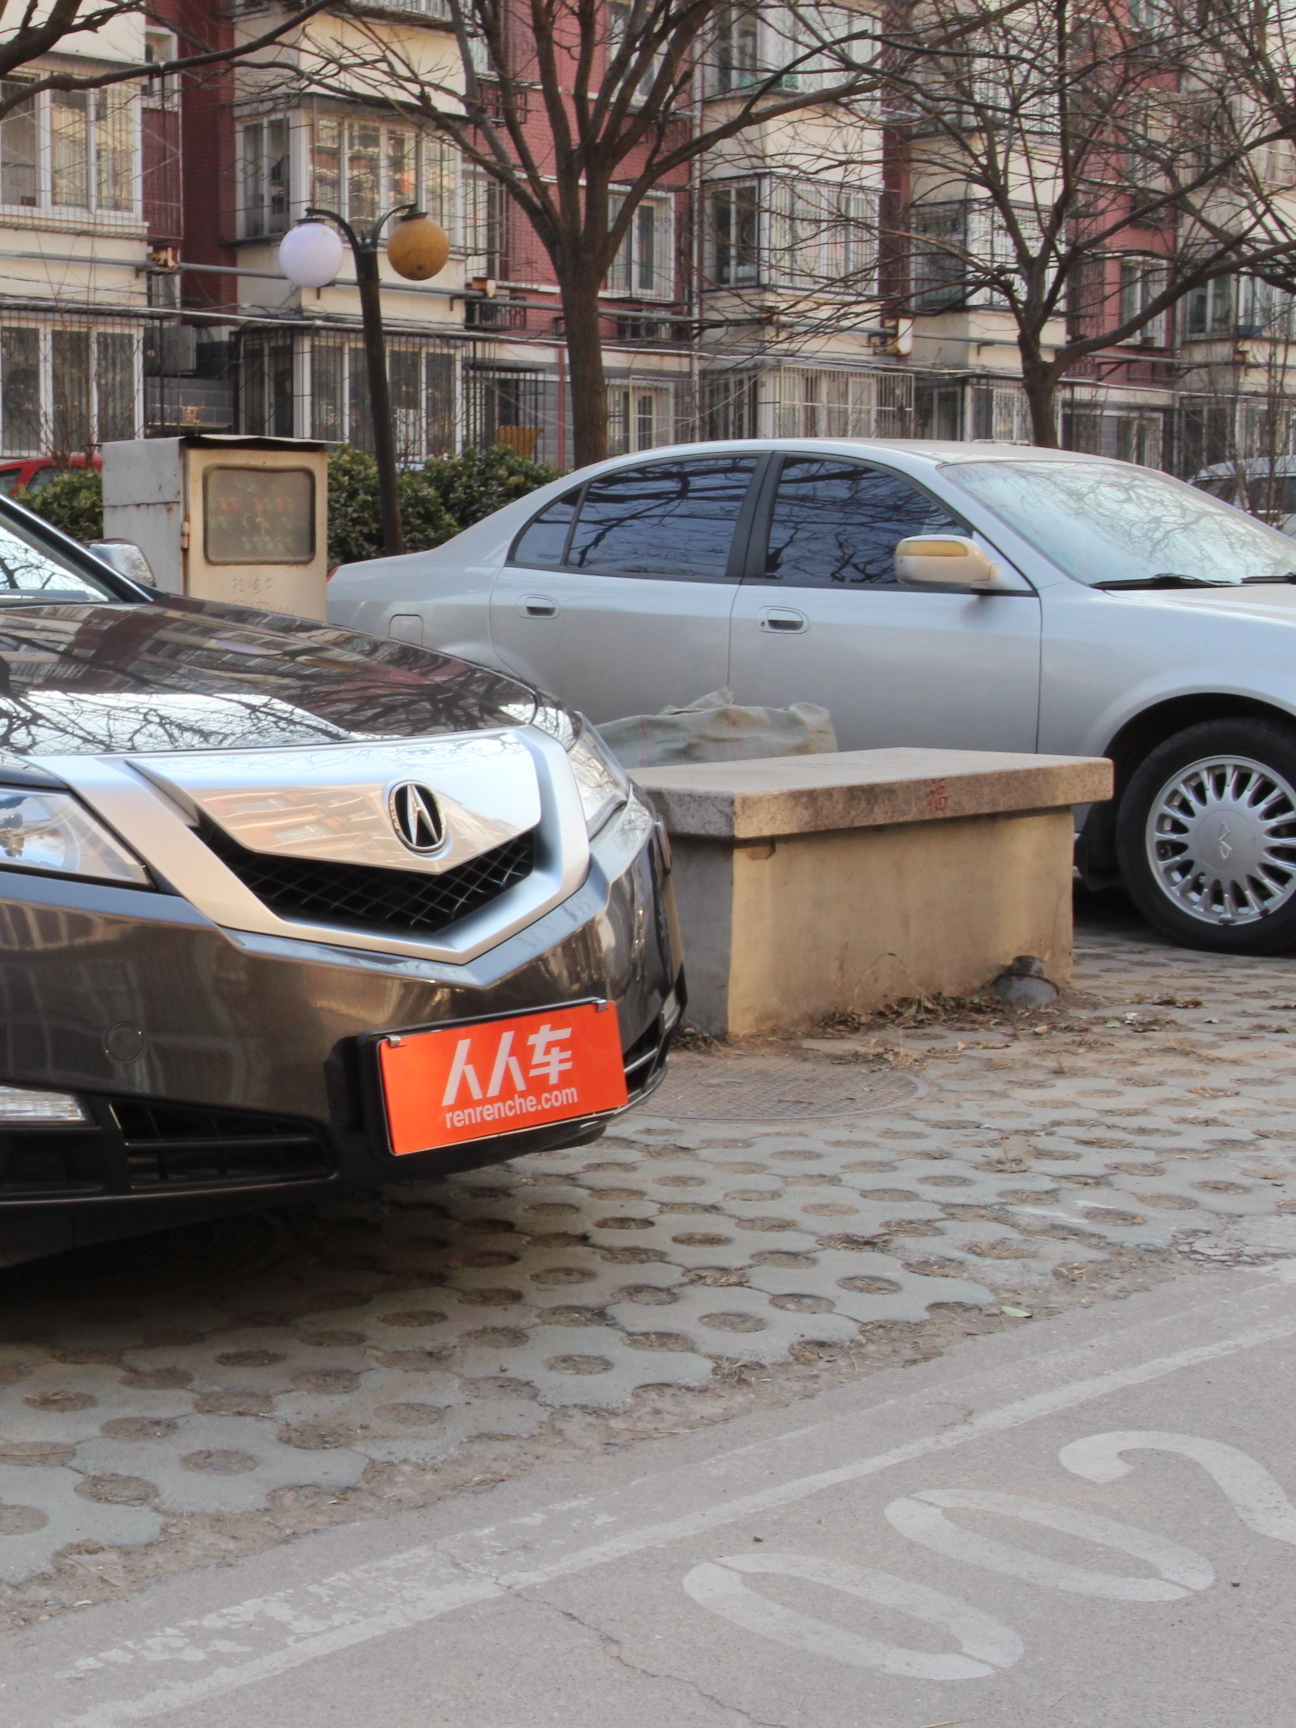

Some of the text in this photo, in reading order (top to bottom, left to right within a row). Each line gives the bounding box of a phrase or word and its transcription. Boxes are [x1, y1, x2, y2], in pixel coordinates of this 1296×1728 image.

[441, 1024, 574, 1107] 人人车
[445, 1086, 578, 1129] renrenche.com
